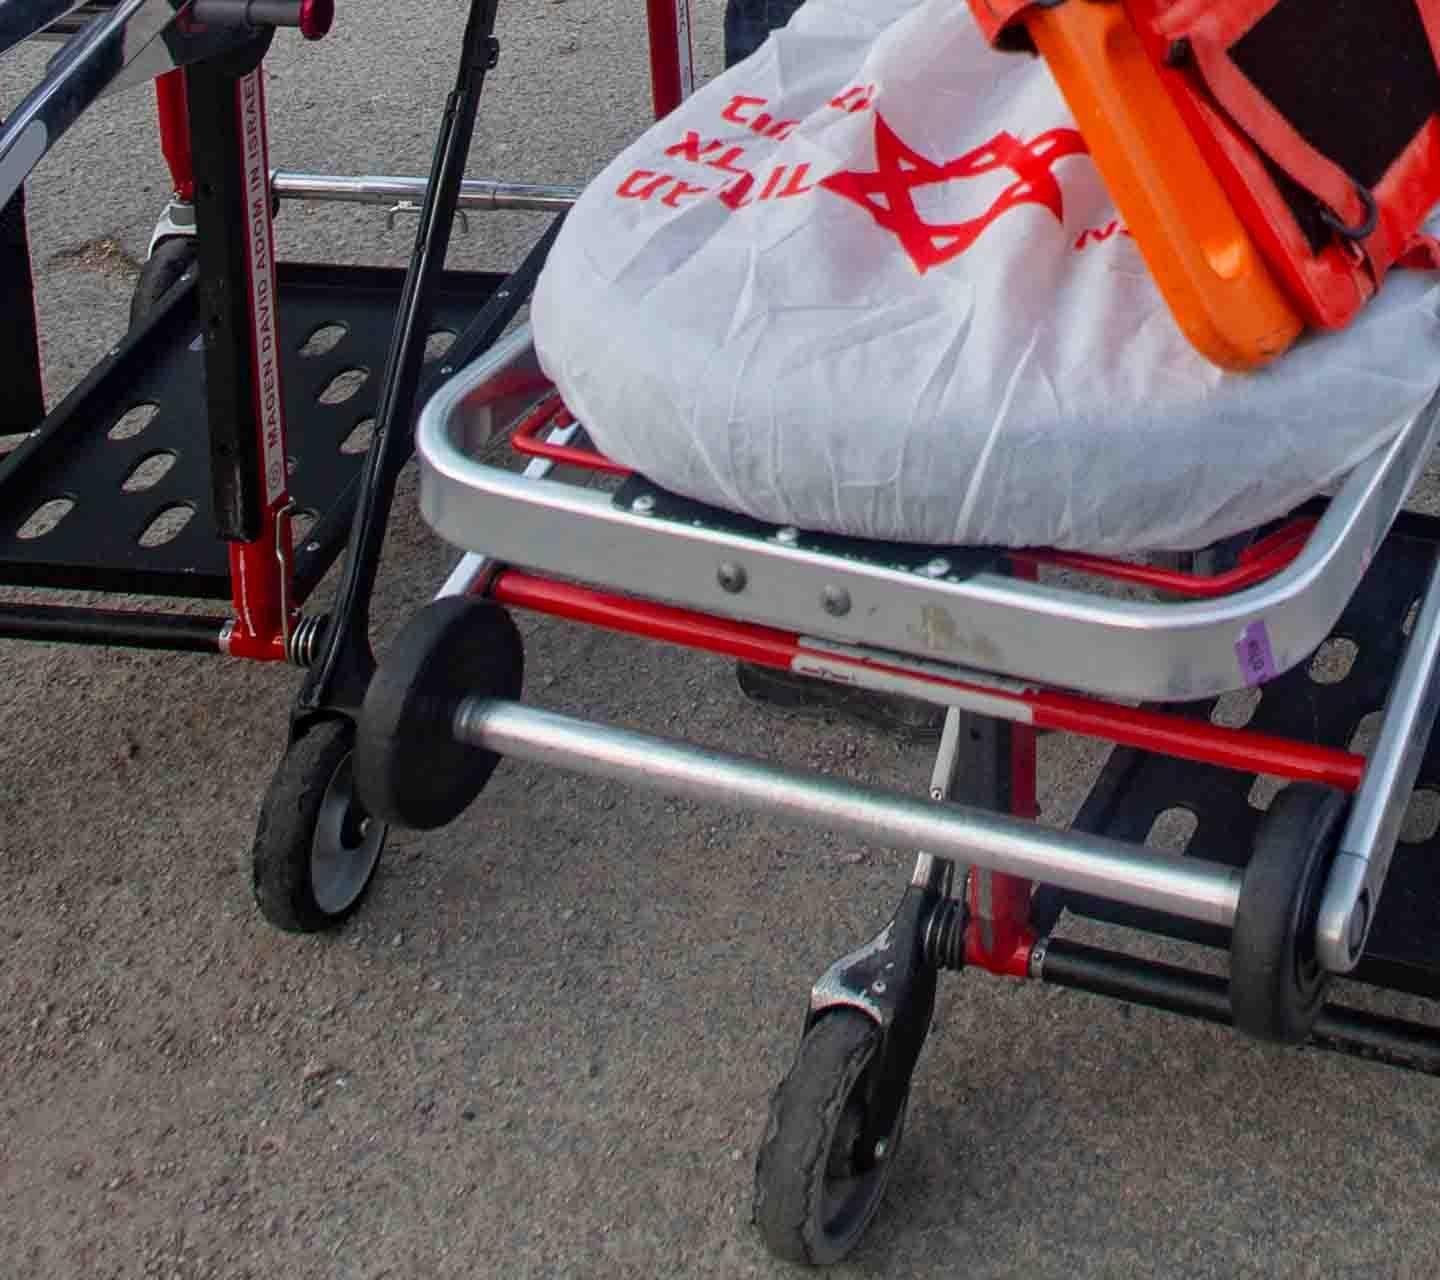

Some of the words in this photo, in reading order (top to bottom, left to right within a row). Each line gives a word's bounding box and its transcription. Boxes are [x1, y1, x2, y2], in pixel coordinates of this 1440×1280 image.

[249, 166, 261, 193] IN
[252, 200, 266, 270] ADOM
[257, 278, 272, 353] DAVID
[263, 357, 278, 449] MAGEN
